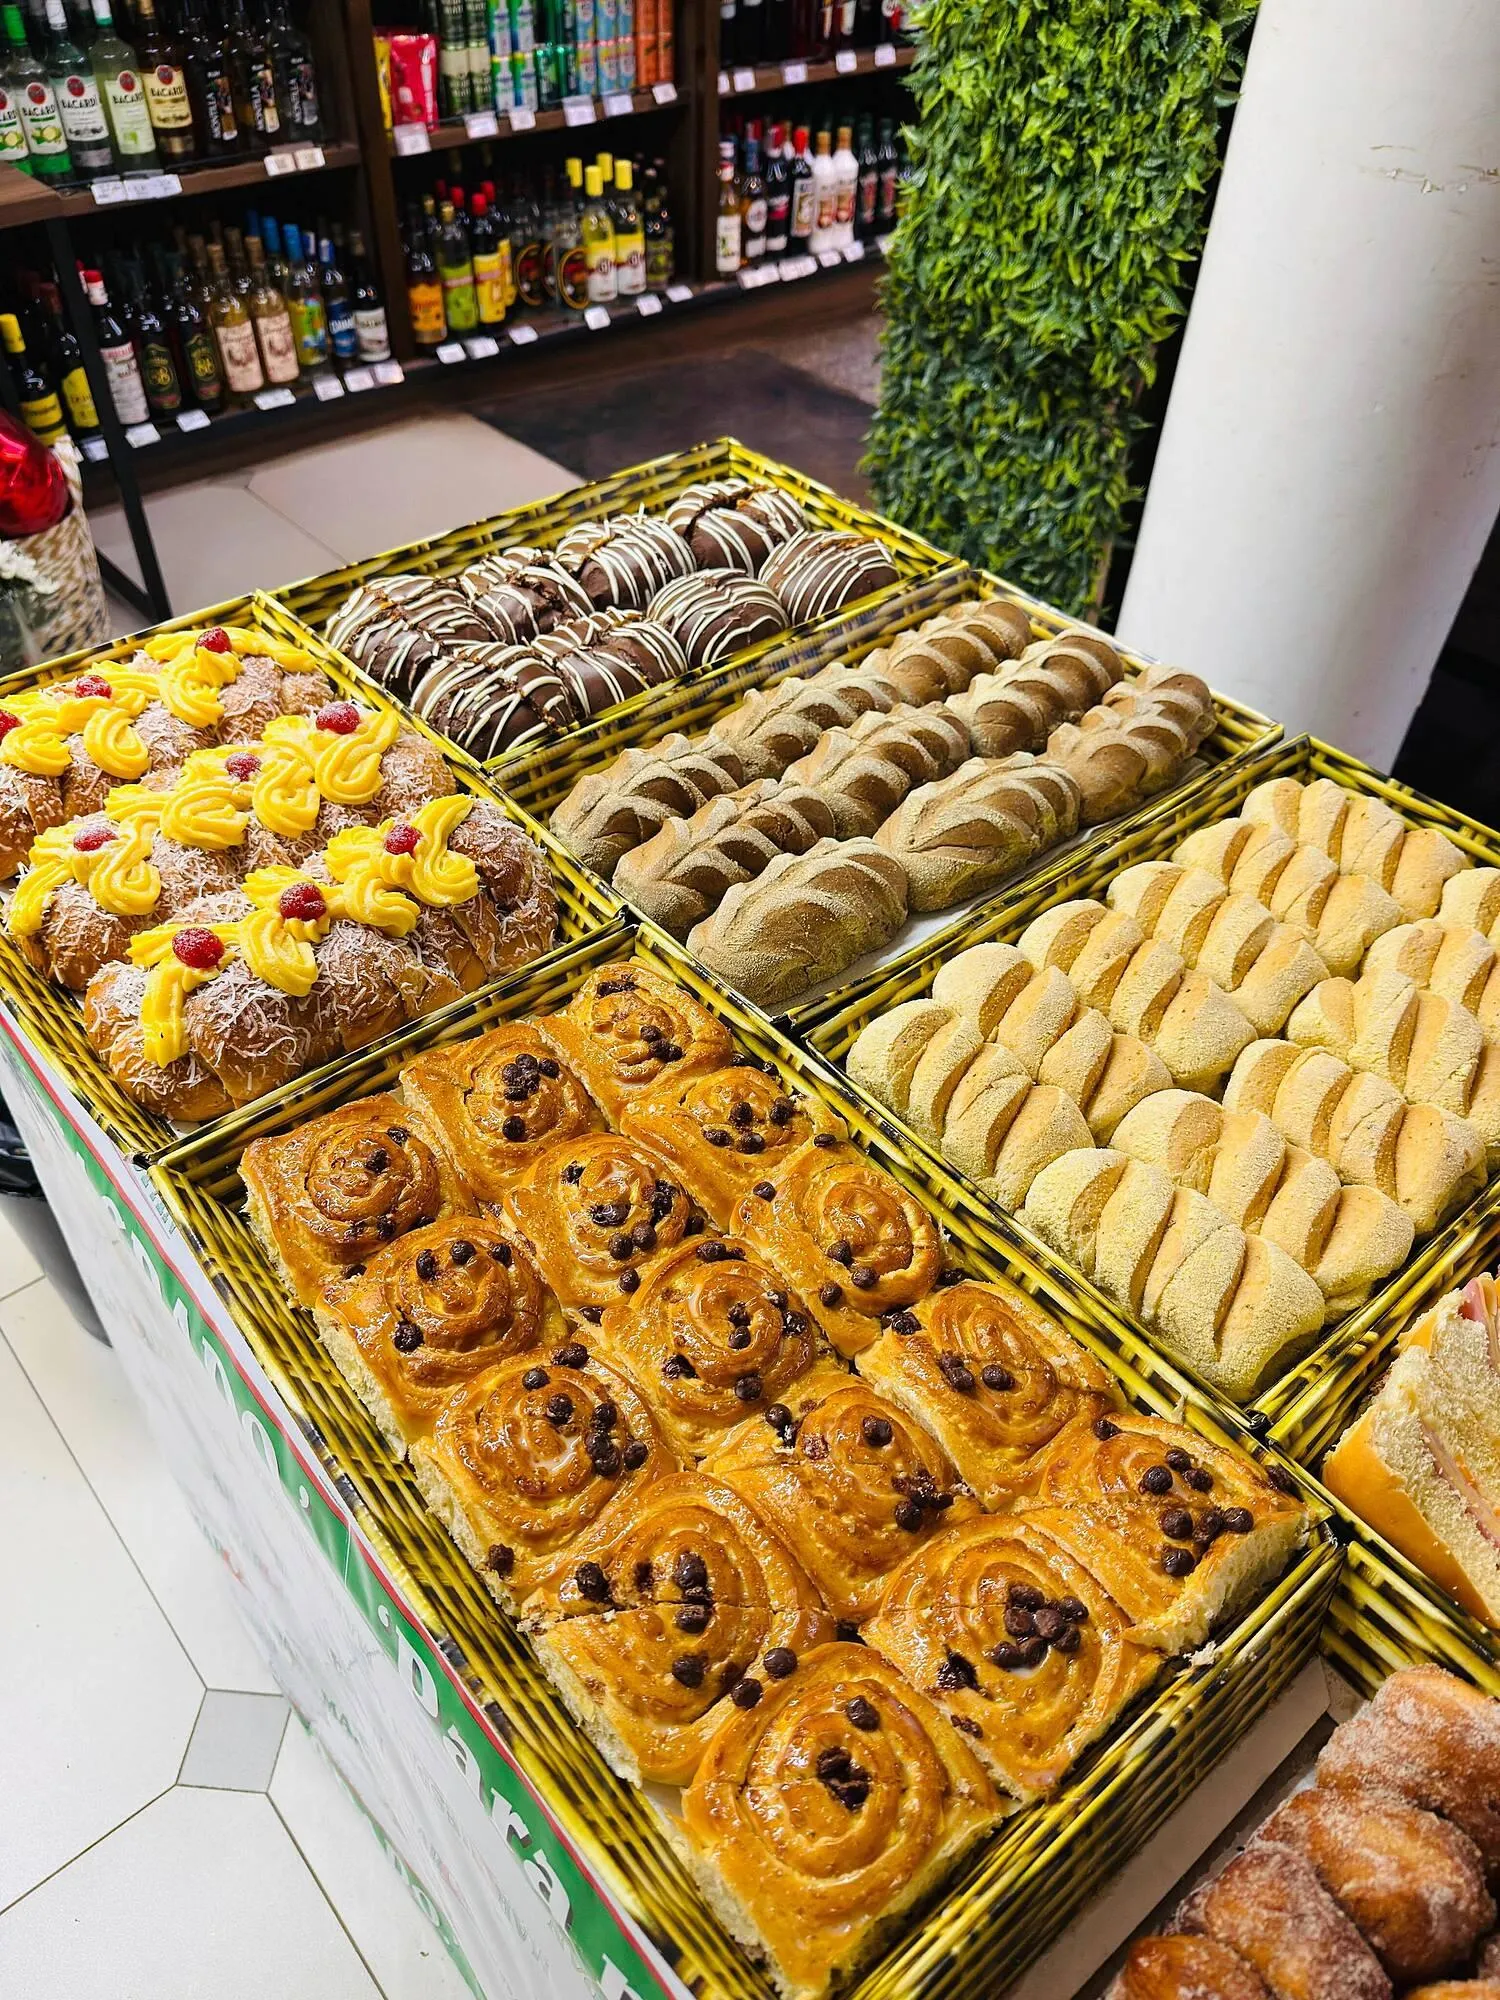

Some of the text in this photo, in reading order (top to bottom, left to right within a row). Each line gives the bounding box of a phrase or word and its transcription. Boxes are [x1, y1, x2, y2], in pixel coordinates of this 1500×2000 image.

[61, 95, 98, 109] BACARDI
[112, 91, 145, 104] BACARD
[22, 104, 57, 117] BACARD
